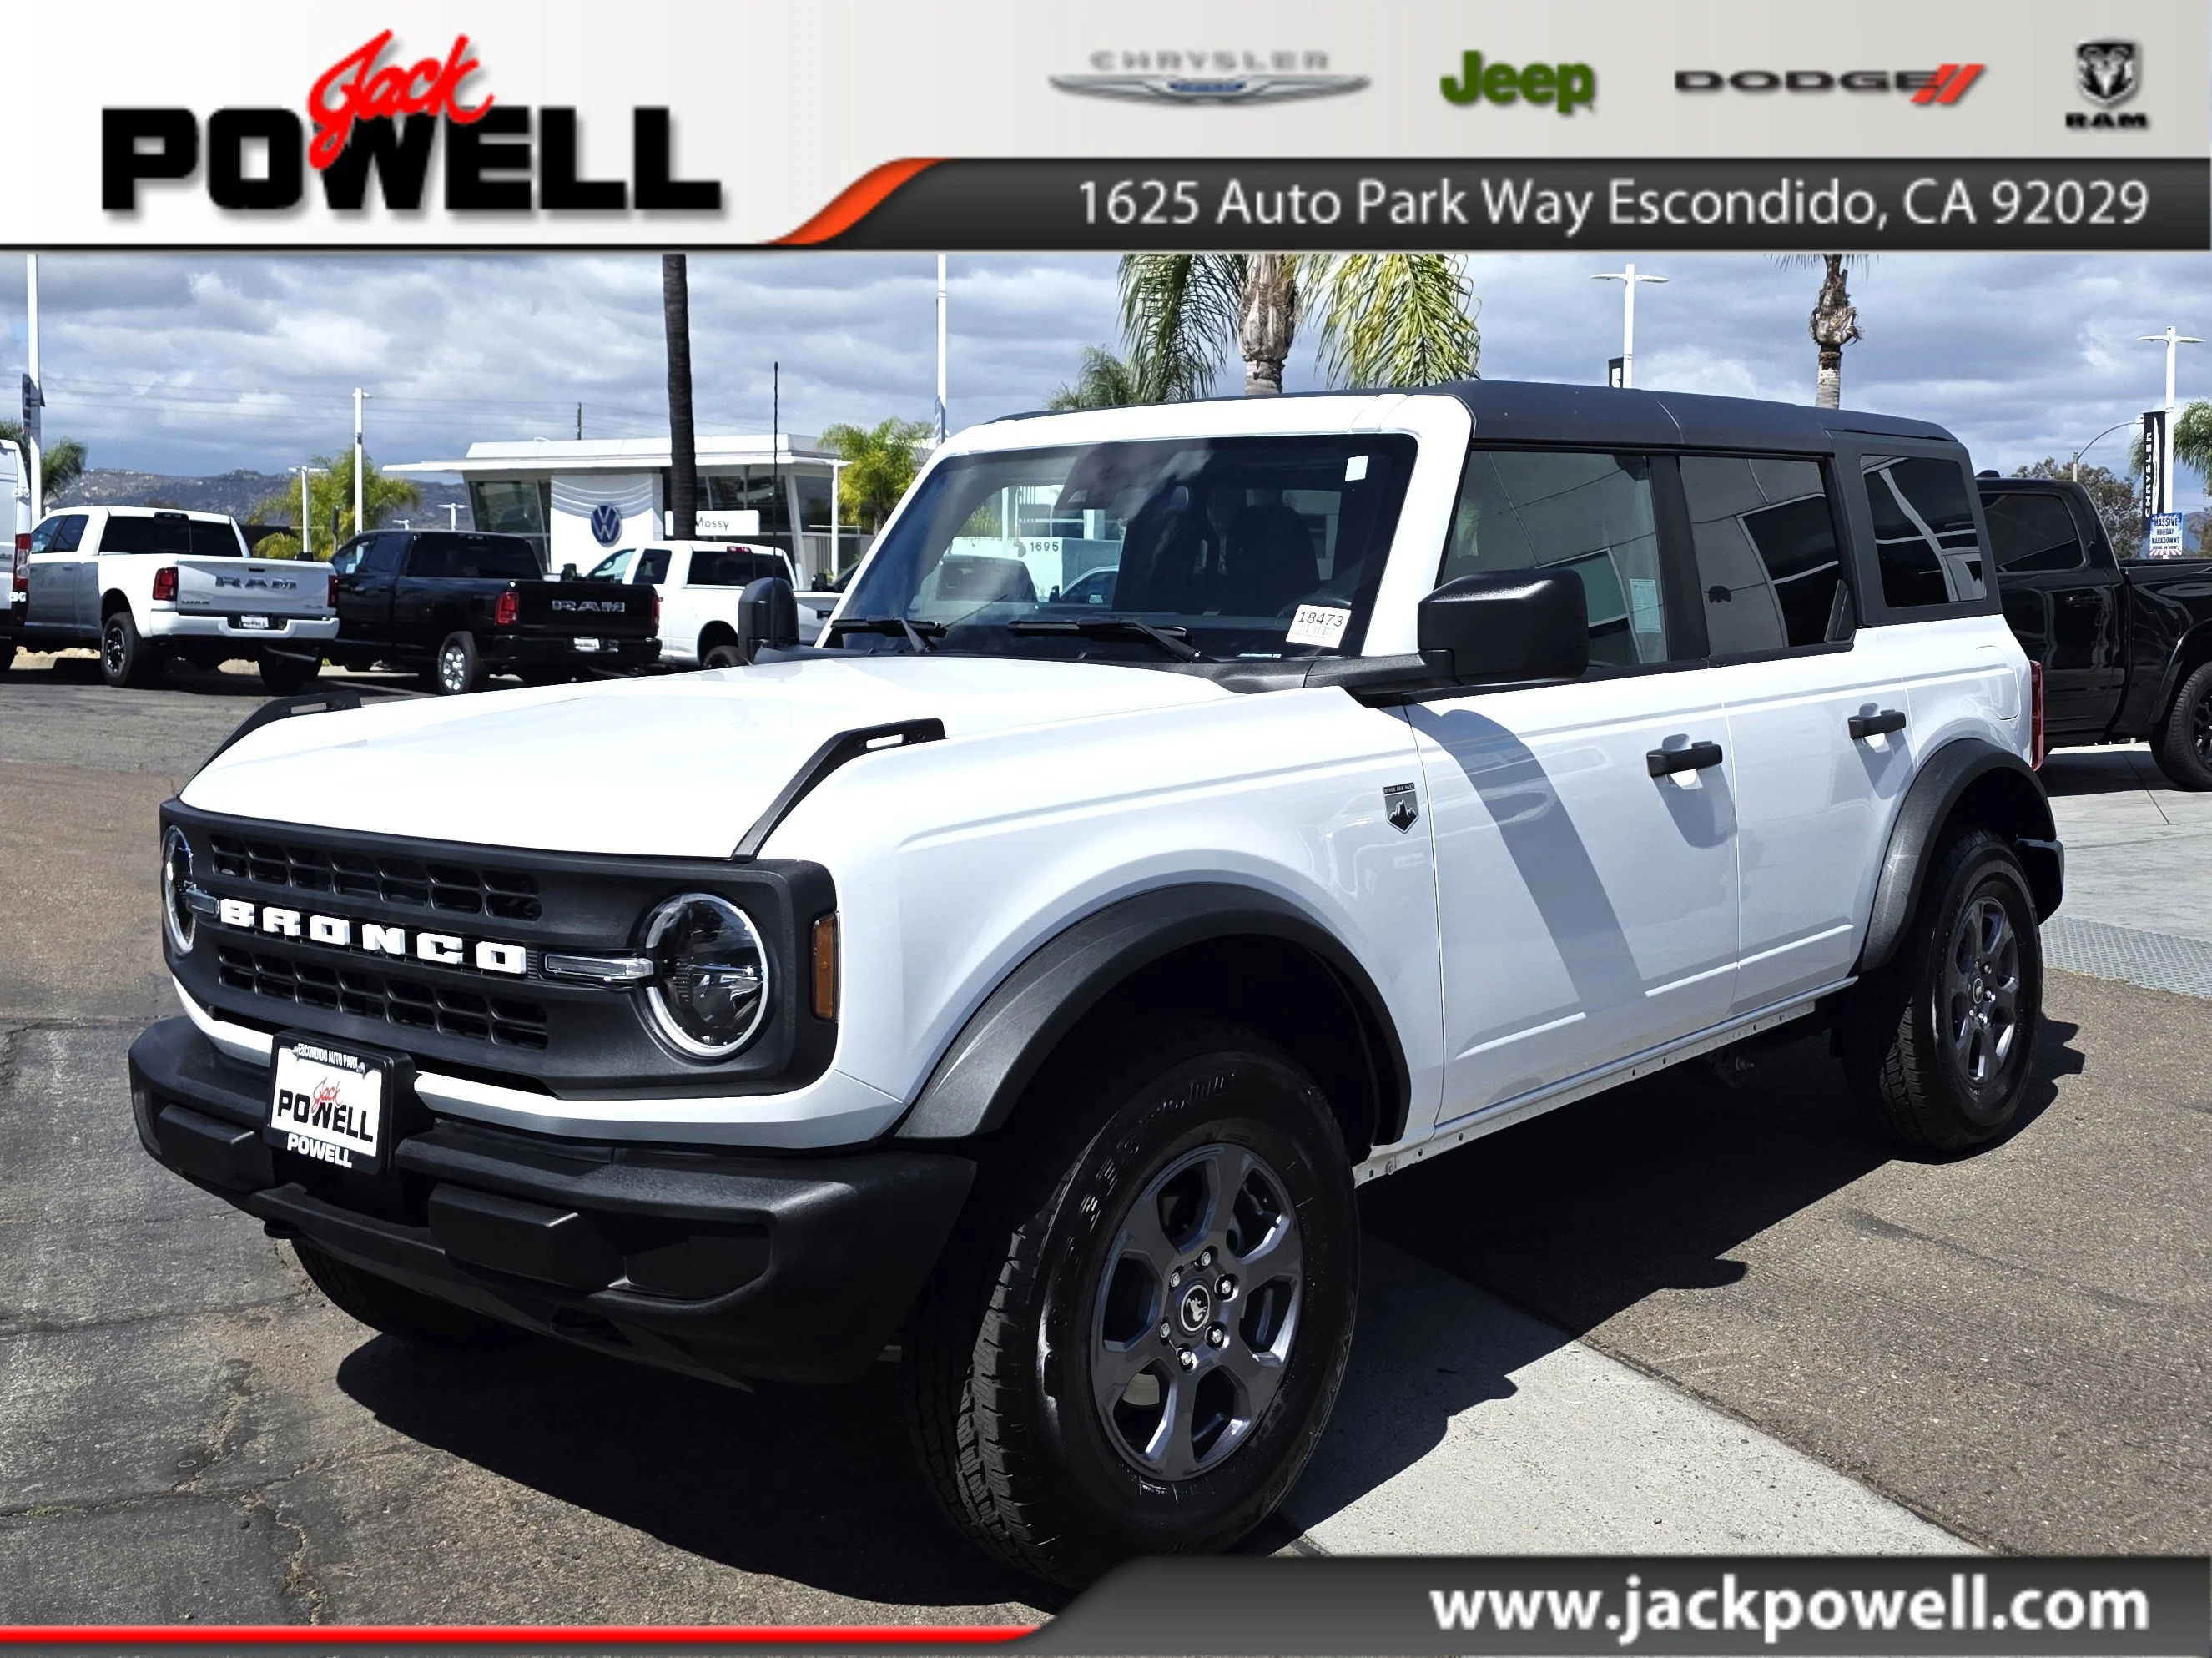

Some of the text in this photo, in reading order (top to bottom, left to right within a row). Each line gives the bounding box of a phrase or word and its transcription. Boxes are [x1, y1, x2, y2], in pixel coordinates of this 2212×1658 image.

[2154, 517, 2179, 527] MASSIVE
[1030, 541, 1059, 552] 1695
[215, 575, 297, 590] RAM
[552, 600, 626, 612] RAM
[1297, 611, 1344, 627] 18473
[220, 898, 527, 975] BRONCO
[328, 1050, 343, 1066] AUTO
[311, 1076, 344, 1114] Jack
[277, 1088, 374, 1143] POWELL
[286, 1132, 353, 1169] POWELL
